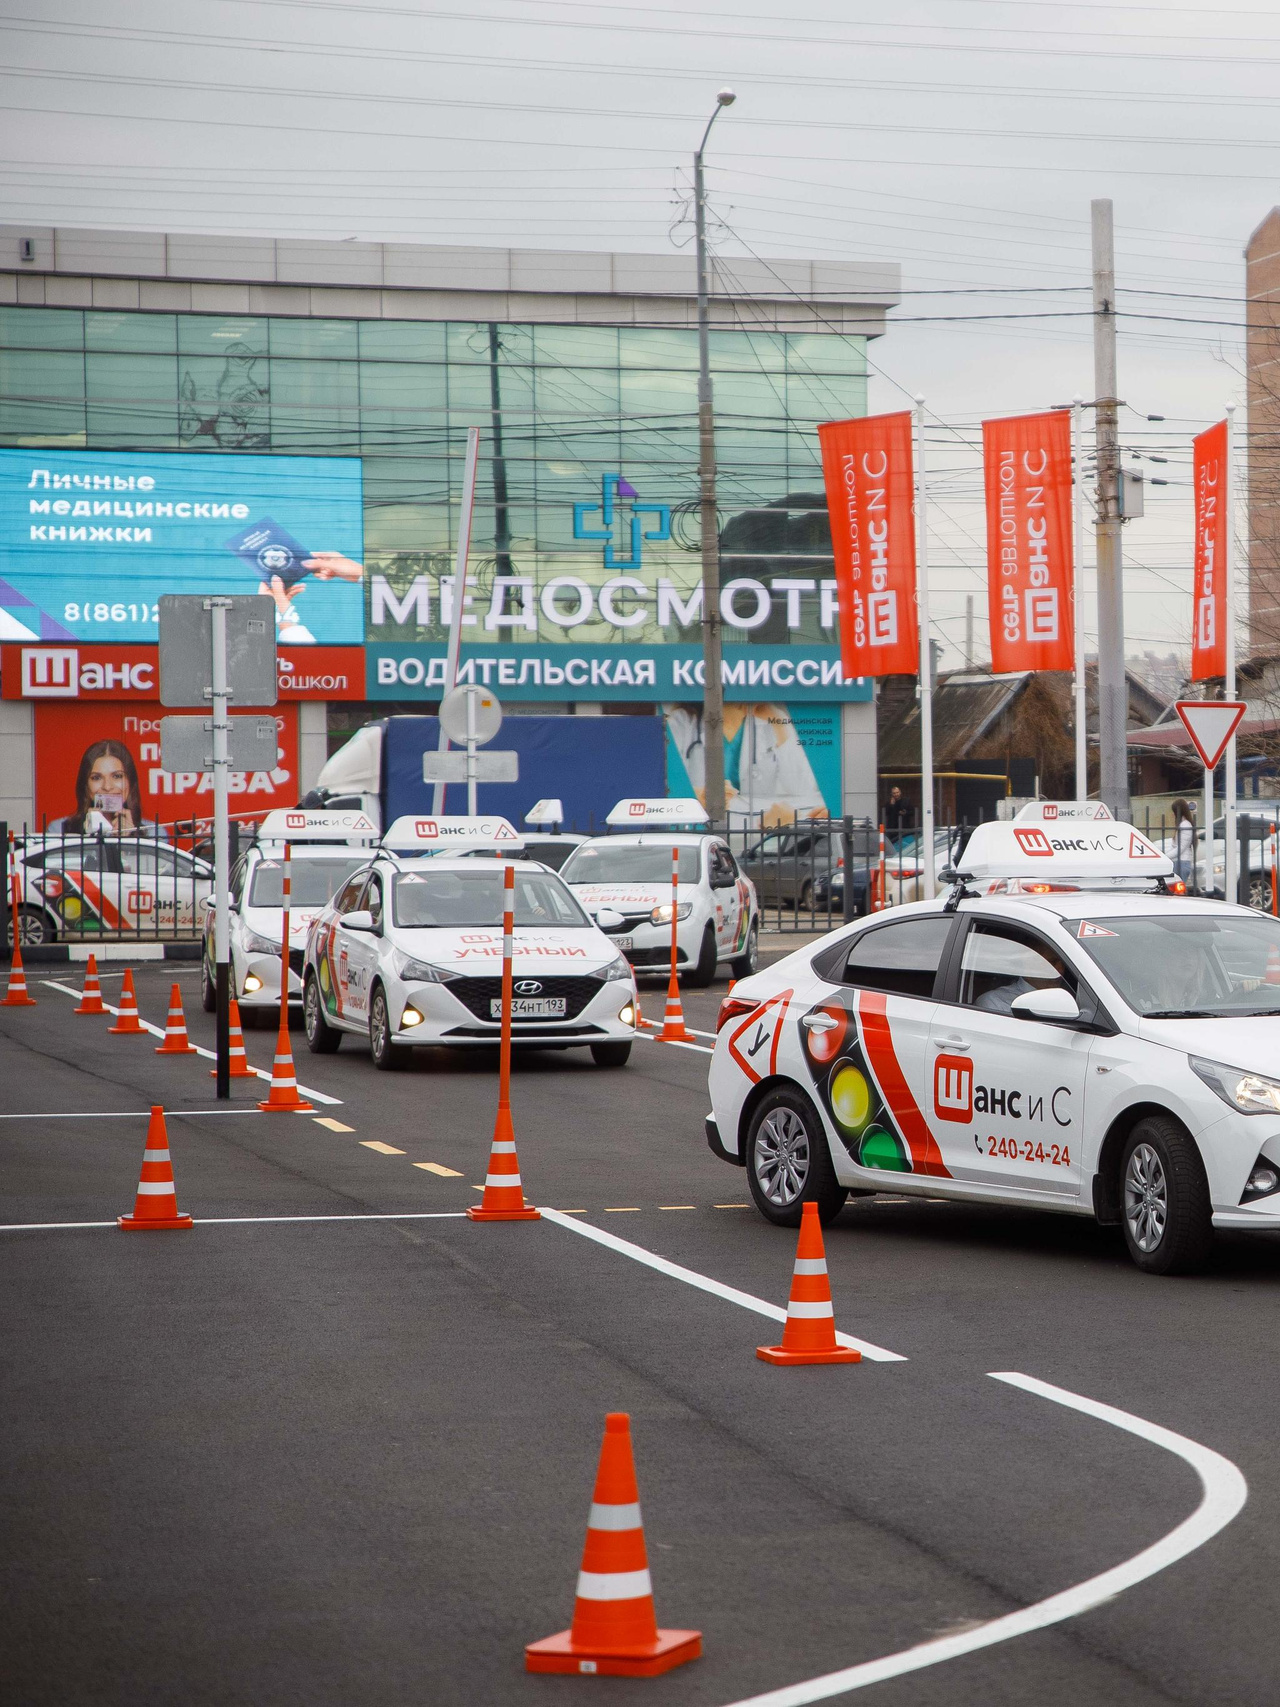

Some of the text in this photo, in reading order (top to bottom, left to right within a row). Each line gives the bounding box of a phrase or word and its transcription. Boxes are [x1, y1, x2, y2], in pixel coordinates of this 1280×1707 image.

[28, 469, 155, 491] Личные
[29, 499, 250, 518] медицинские
[30, 525, 152, 542] книжки
[21, 648, 154, 697] Шанс
[377, 658, 864, 687] ВОДИТЕЛЬСКАЯ КМИССИ
[277, 674, 347, 691] ошкол
[768, 717, 833, 726] Медицинская
[809, 738, 814, 746] 2
[149, 768, 275, 794] ПРАВА
[629, 803, 665, 816] Шанс
[675, 805, 684, 813] С
[1043, 804, 1075, 820] Шанс
[1085, 807, 1093, 816] С
[286, 814, 329, 828] Шанс
[342, 817, 352, 826] С
[415, 821, 465, 838] Шанс
[480, 824, 492, 835] С
[1013, 828, 1124, 857] Шанс и С
[1135, 845, 1145, 855] У
[453, 946, 587, 958] УЧЕБНЫЙ
[494, 999, 563, 1013] Х34НТ 193
[747, 1022, 771, 1057] У
[933, 1053, 1072, 1127] Шанс и С
[987, 1135, 1071, 1167] 240-24-24
